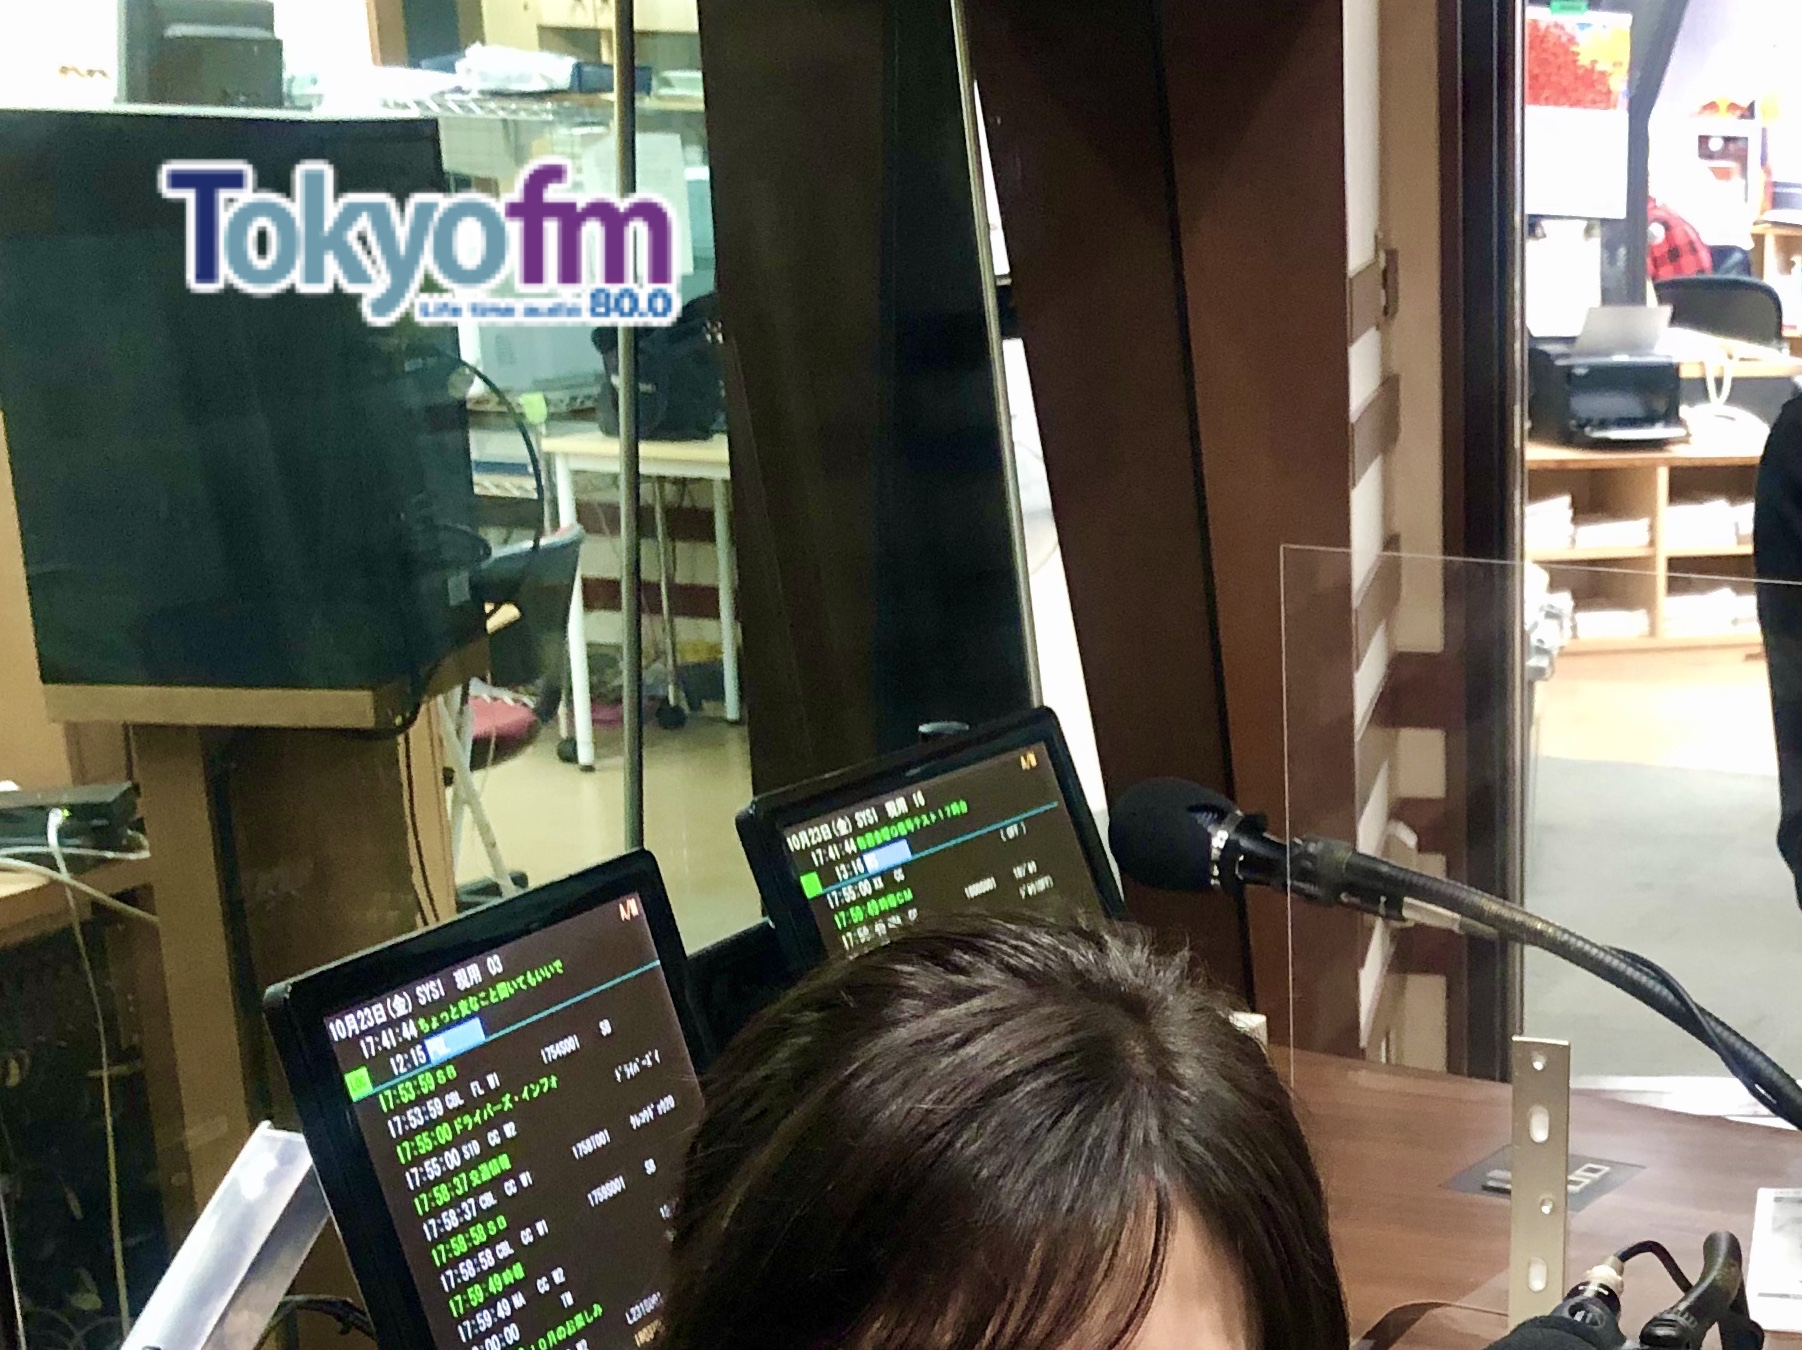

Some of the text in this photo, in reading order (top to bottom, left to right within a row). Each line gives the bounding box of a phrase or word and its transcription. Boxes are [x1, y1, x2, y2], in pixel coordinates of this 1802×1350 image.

[855, 807, 878, 828] SYS1
[811, 838, 857, 866] 17:41:44
[827, 879, 872, 908] 17:55:00
[329, 954, 503, 1041] 10月23日(金) SYS1 現用 03
[360, 1019, 417, 1059] 17:41:44
[390, 1045, 430, 1079] 12:15
[379, 1072, 435, 1112] 17:53:59
[388, 1097, 443, 1138] 17:53:59
[397, 1075, 557, 1164] 17:55:00 ドライバーズ・インフォ
[406, 1148, 461, 1190] 17:55:00
[414, 1154, 511, 1215] 17:58:37 交通情報
[423, 1198, 476, 1241] 17:58:37
[432, 1223, 487, 1266] 17:58:58
[441, 1248, 495, 1292] 17:58:58
[449, 1273, 503, 1317] 17:59:49
[458, 1298, 511, 1342] 17:59:49
